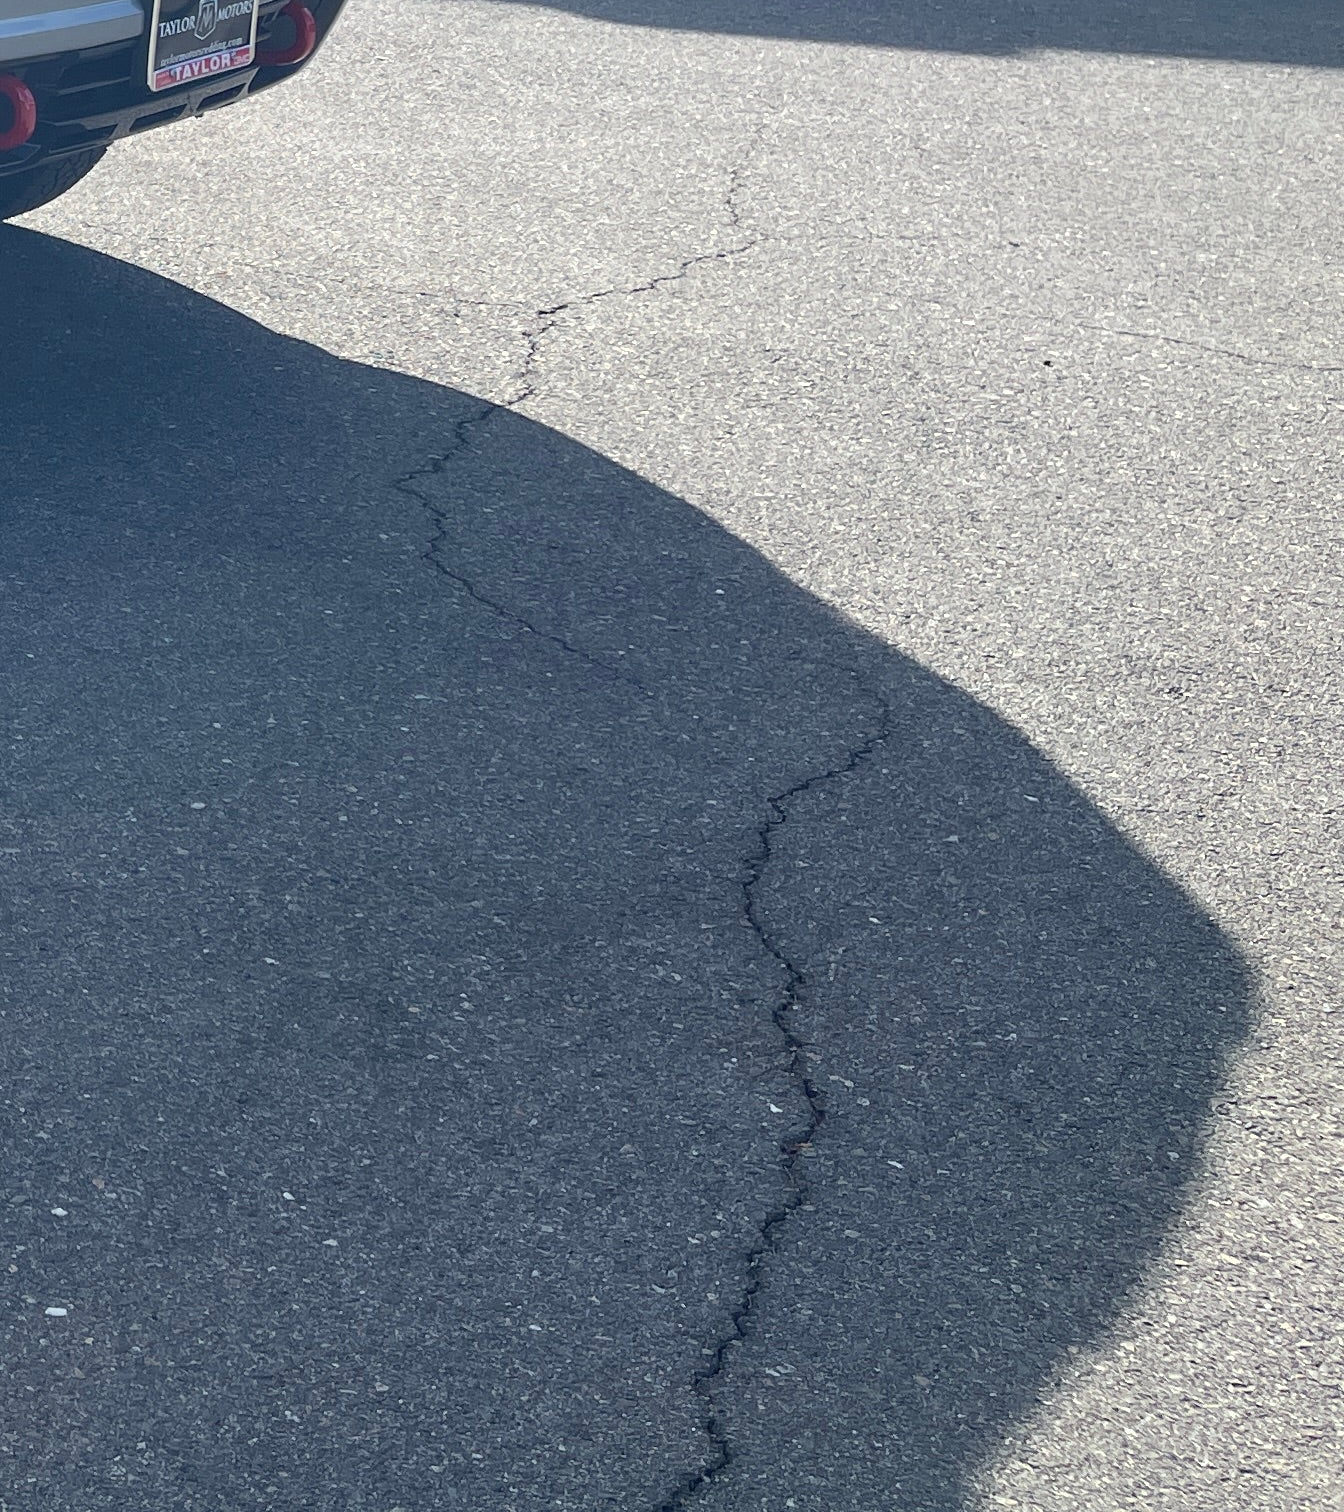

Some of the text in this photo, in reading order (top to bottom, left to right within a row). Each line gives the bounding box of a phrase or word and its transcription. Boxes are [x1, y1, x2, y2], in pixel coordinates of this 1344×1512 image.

[159, 15, 196, 38] TAYLOR
[216, 0, 254, 23] MOTORS
[172, 53, 231, 81] TAYLOR
